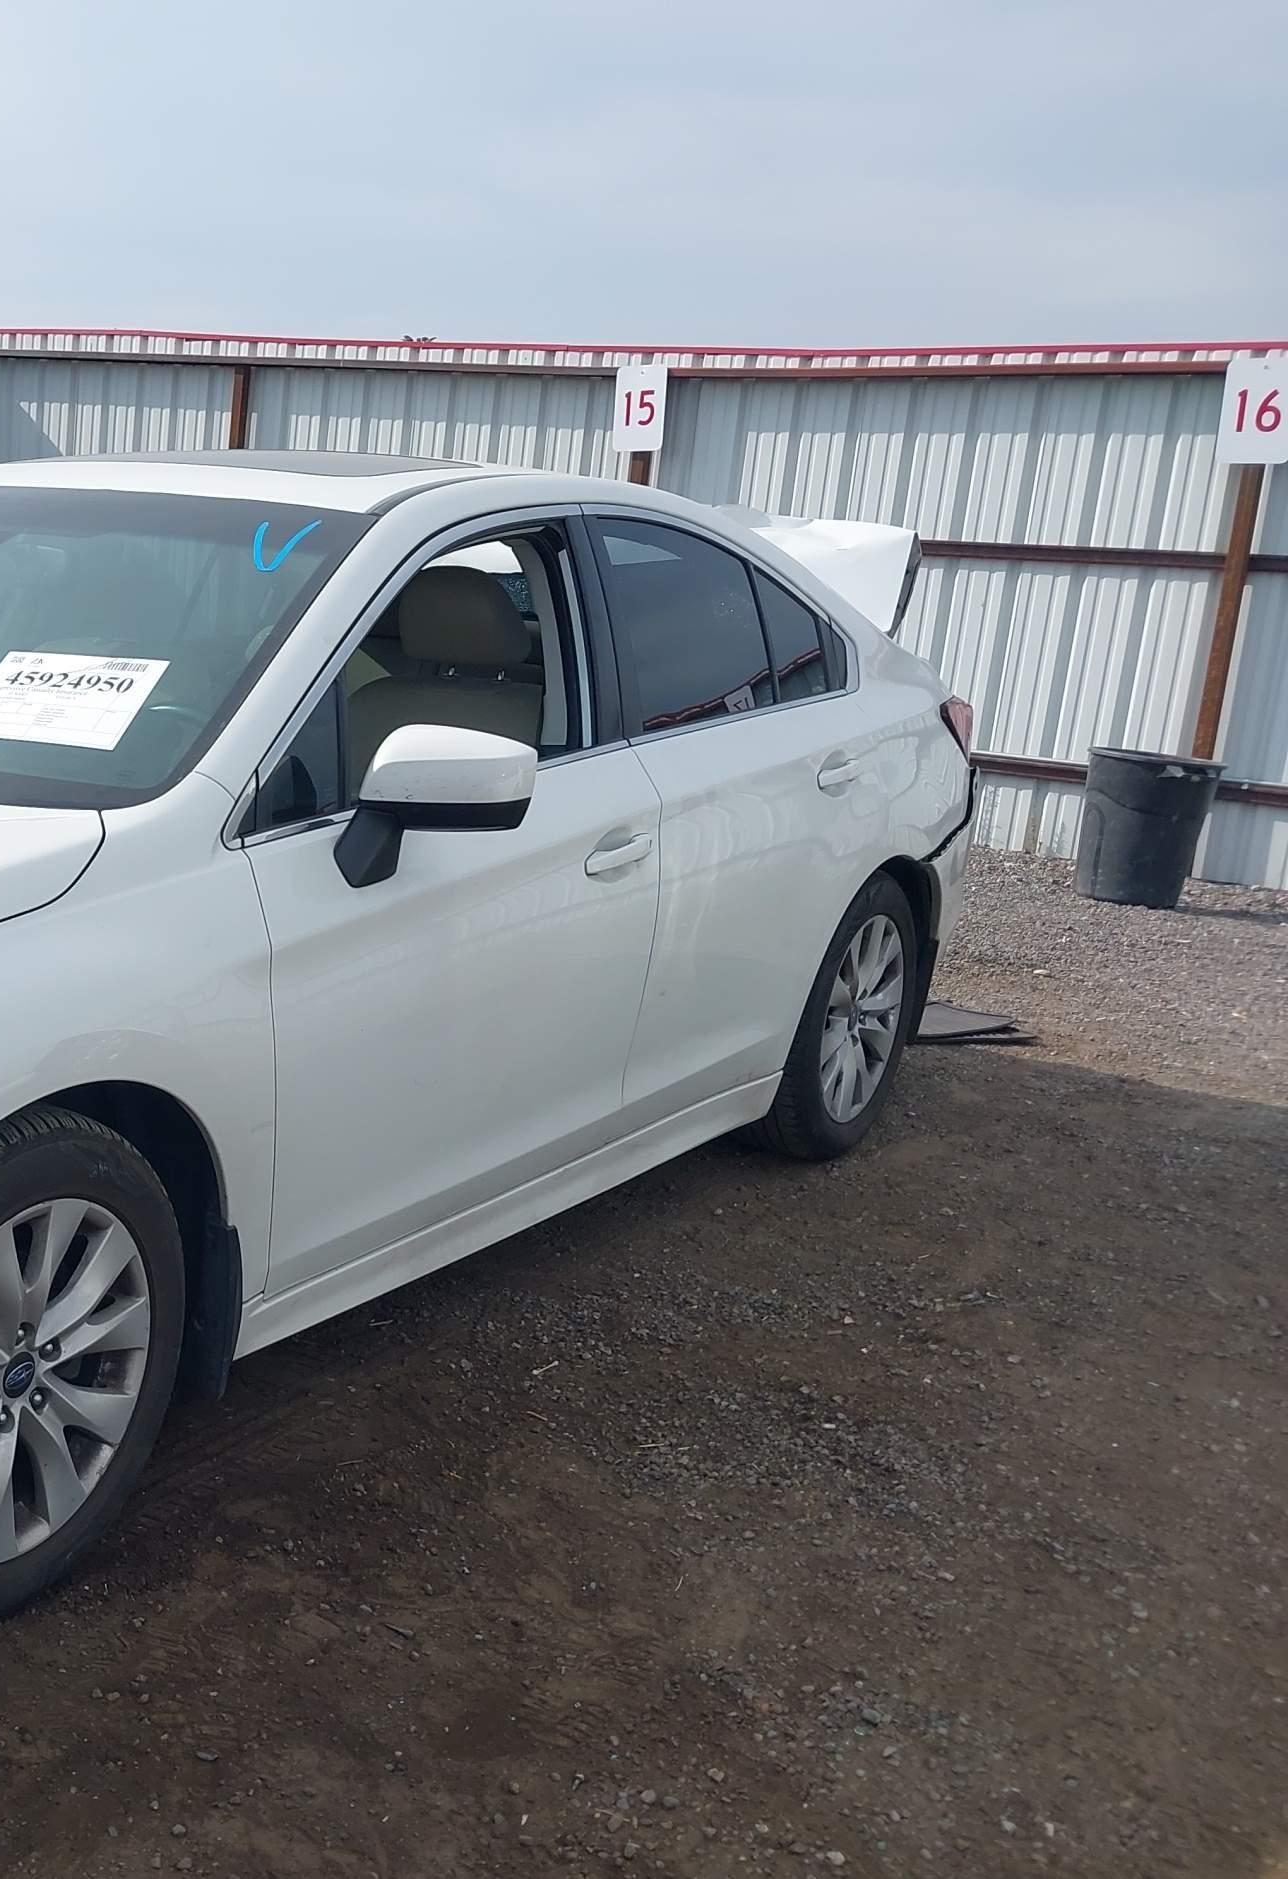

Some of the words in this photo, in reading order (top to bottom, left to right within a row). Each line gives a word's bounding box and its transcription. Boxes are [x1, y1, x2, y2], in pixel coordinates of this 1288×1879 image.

[625, 390, 655, 426] 15
[1235, 388, 1281, 433] 16
[5, 670, 134, 693] 45924950
